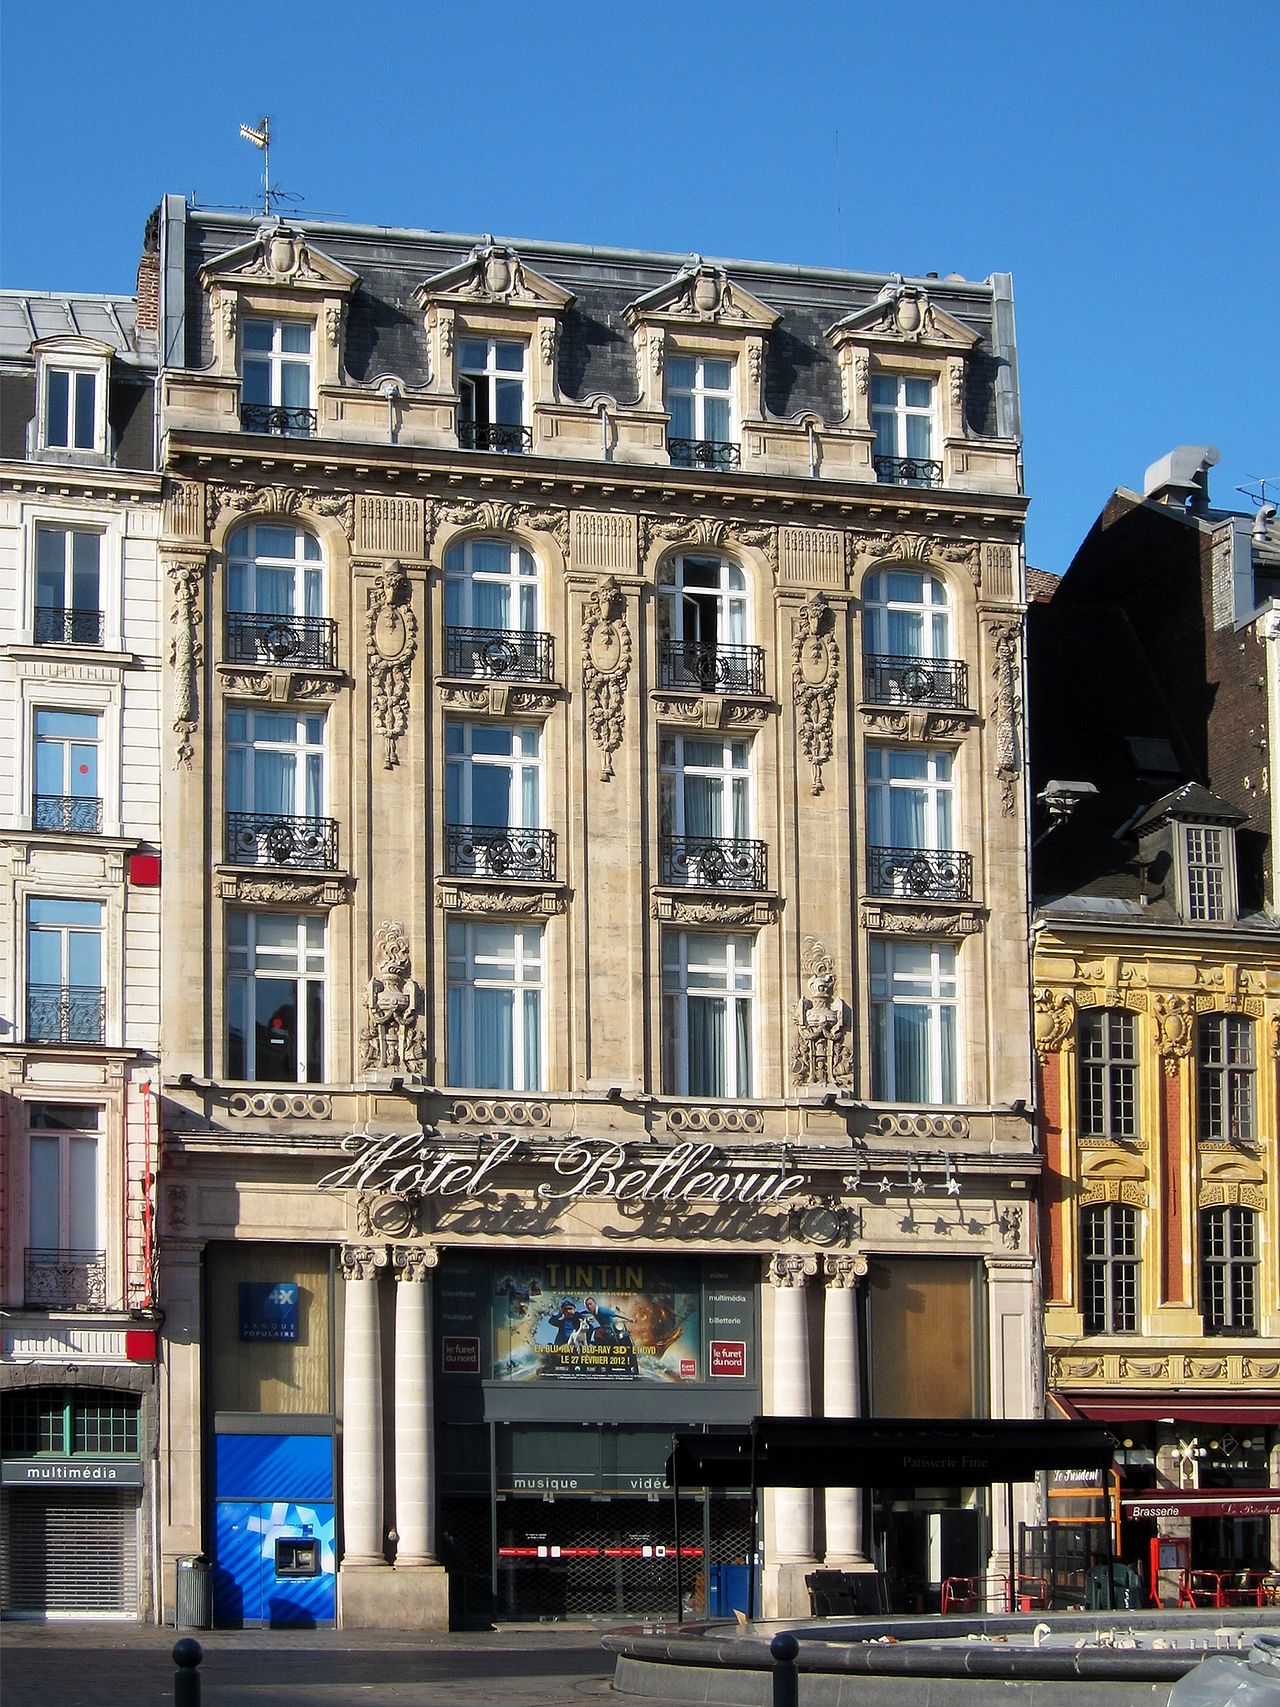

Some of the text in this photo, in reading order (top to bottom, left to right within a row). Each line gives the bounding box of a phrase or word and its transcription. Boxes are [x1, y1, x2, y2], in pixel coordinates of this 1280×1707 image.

[316, 1132, 806, 1203] Hôtel Bellevue
[546, 1263, 643, 1289] TINTIN
[709, 1294, 746, 1303] multimédia
[455, 1344, 475, 1354] furet
[713, 1348, 742, 1358] le furet
[561, 1355, 570, 1364] LE
[571, 1356, 580, 1364] 27
[581, 1354, 609, 1365] FÉVRIER
[610, 1356, 626, 1365] 2012
[713, 1358, 742, 1367] du nord
[961, 1456, 989, 1468] Fine
[27, 1465, 117, 1480] multimédia
[514, 1477, 578, 1490] musique
[1132, 1506, 1179, 1517] Brasserie
